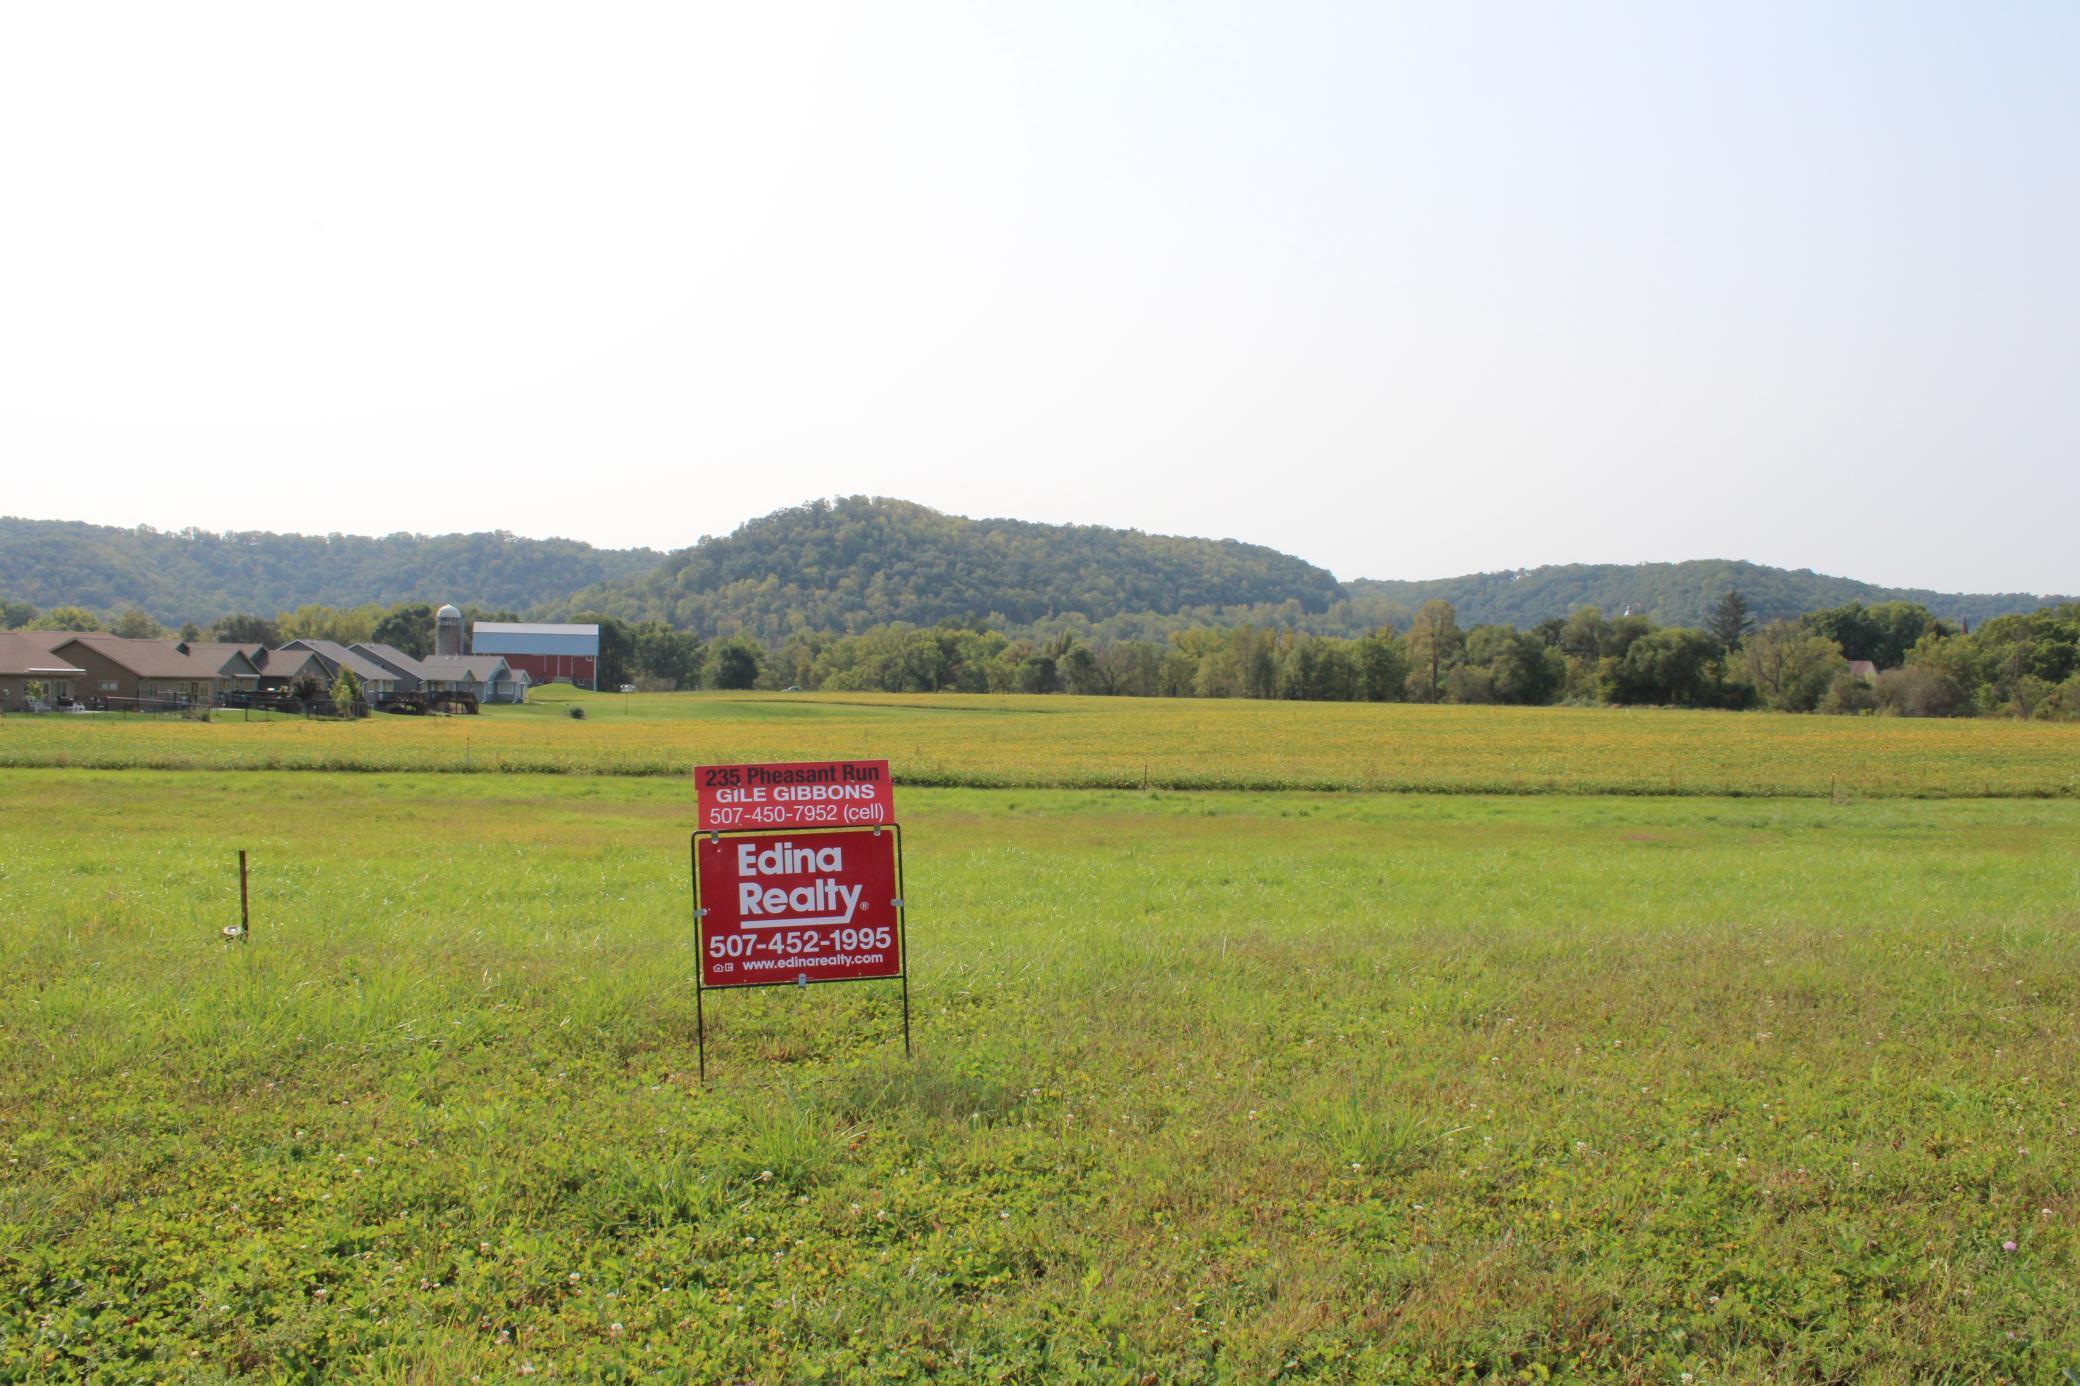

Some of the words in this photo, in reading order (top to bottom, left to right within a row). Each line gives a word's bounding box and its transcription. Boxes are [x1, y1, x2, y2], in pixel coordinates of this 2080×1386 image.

[705, 768, 740, 787] 235
[747, 766, 837, 785] Pheasant
[843, 765, 879, 782] Run
[716, 787, 767, 803] GILE
[774, 785, 875, 801] GIBBONS
[710, 805, 838, 824] 507-450-7952
[843, 803, 884, 824] (cell)
[738, 842, 843, 877] Edina
[739, 879, 863, 924] Realty
[710, 927, 892, 958] 507-452-1995
[743, 953, 884, 971] www.edinarealty.com
